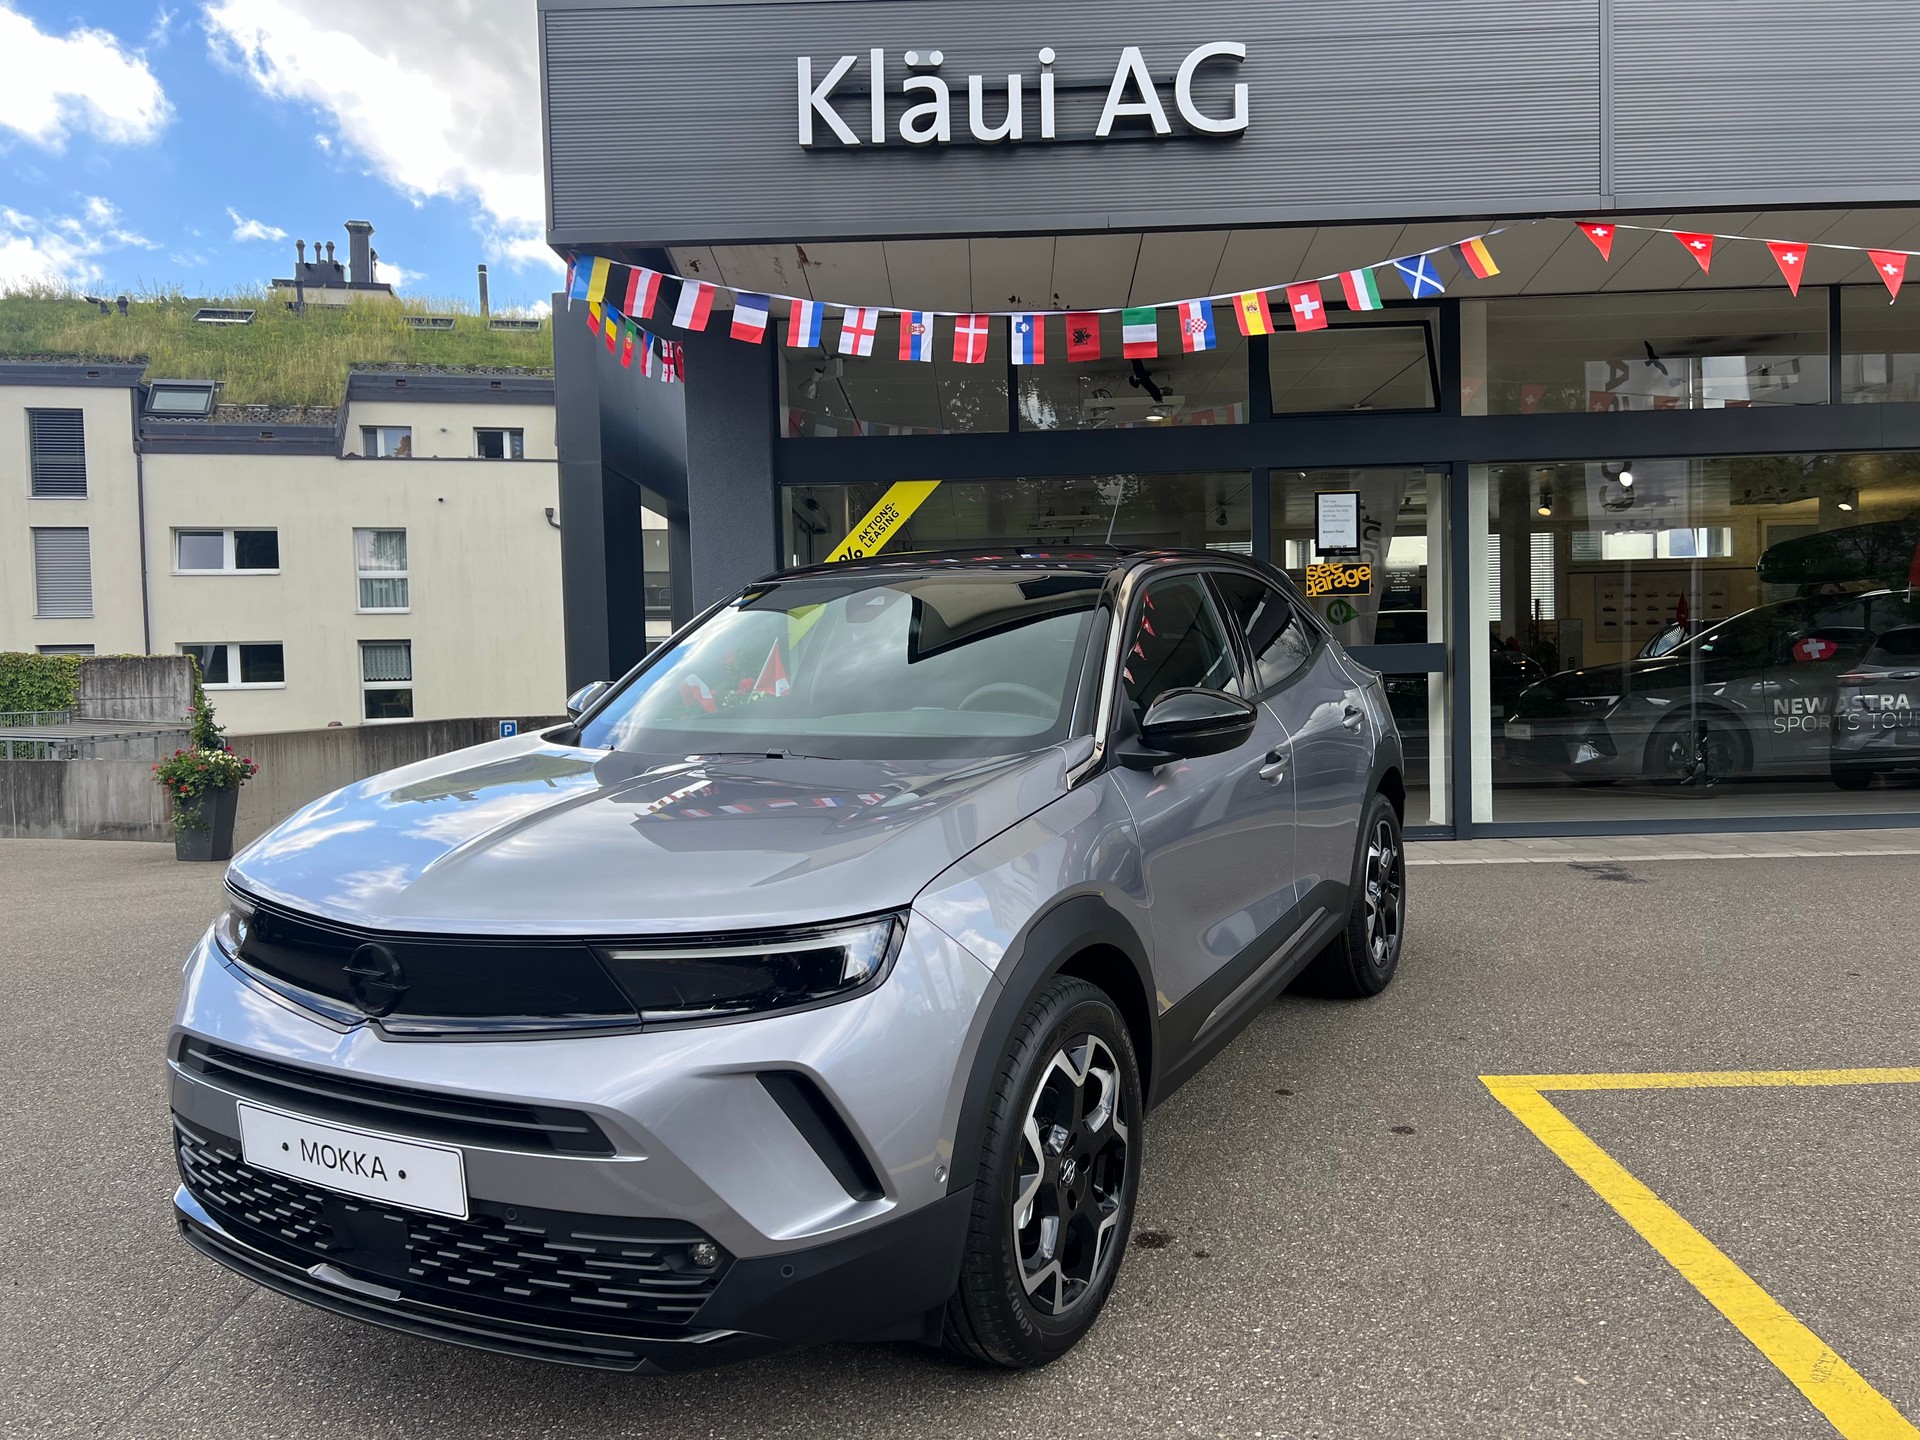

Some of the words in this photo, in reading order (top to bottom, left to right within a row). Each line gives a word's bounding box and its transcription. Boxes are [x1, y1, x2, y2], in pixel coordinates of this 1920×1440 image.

[797, 47, 1056, 146] Kläui
[1095, 41, 1249, 137] AG
[858, 502, 896, 543] AKTIONS-
[864, 510, 900, 548] LEASING
[1307, 563, 1344, 581] see
[1307, 566, 1370, 595] garage
[1773, 697, 1828, 714] NEW
[1835, 694, 1911, 713] ASTRA
[504, 725, 513, 735] P
[1773, 713, 1860, 733] SPORTS
[300, 1138, 388, 1182] MOKKA
